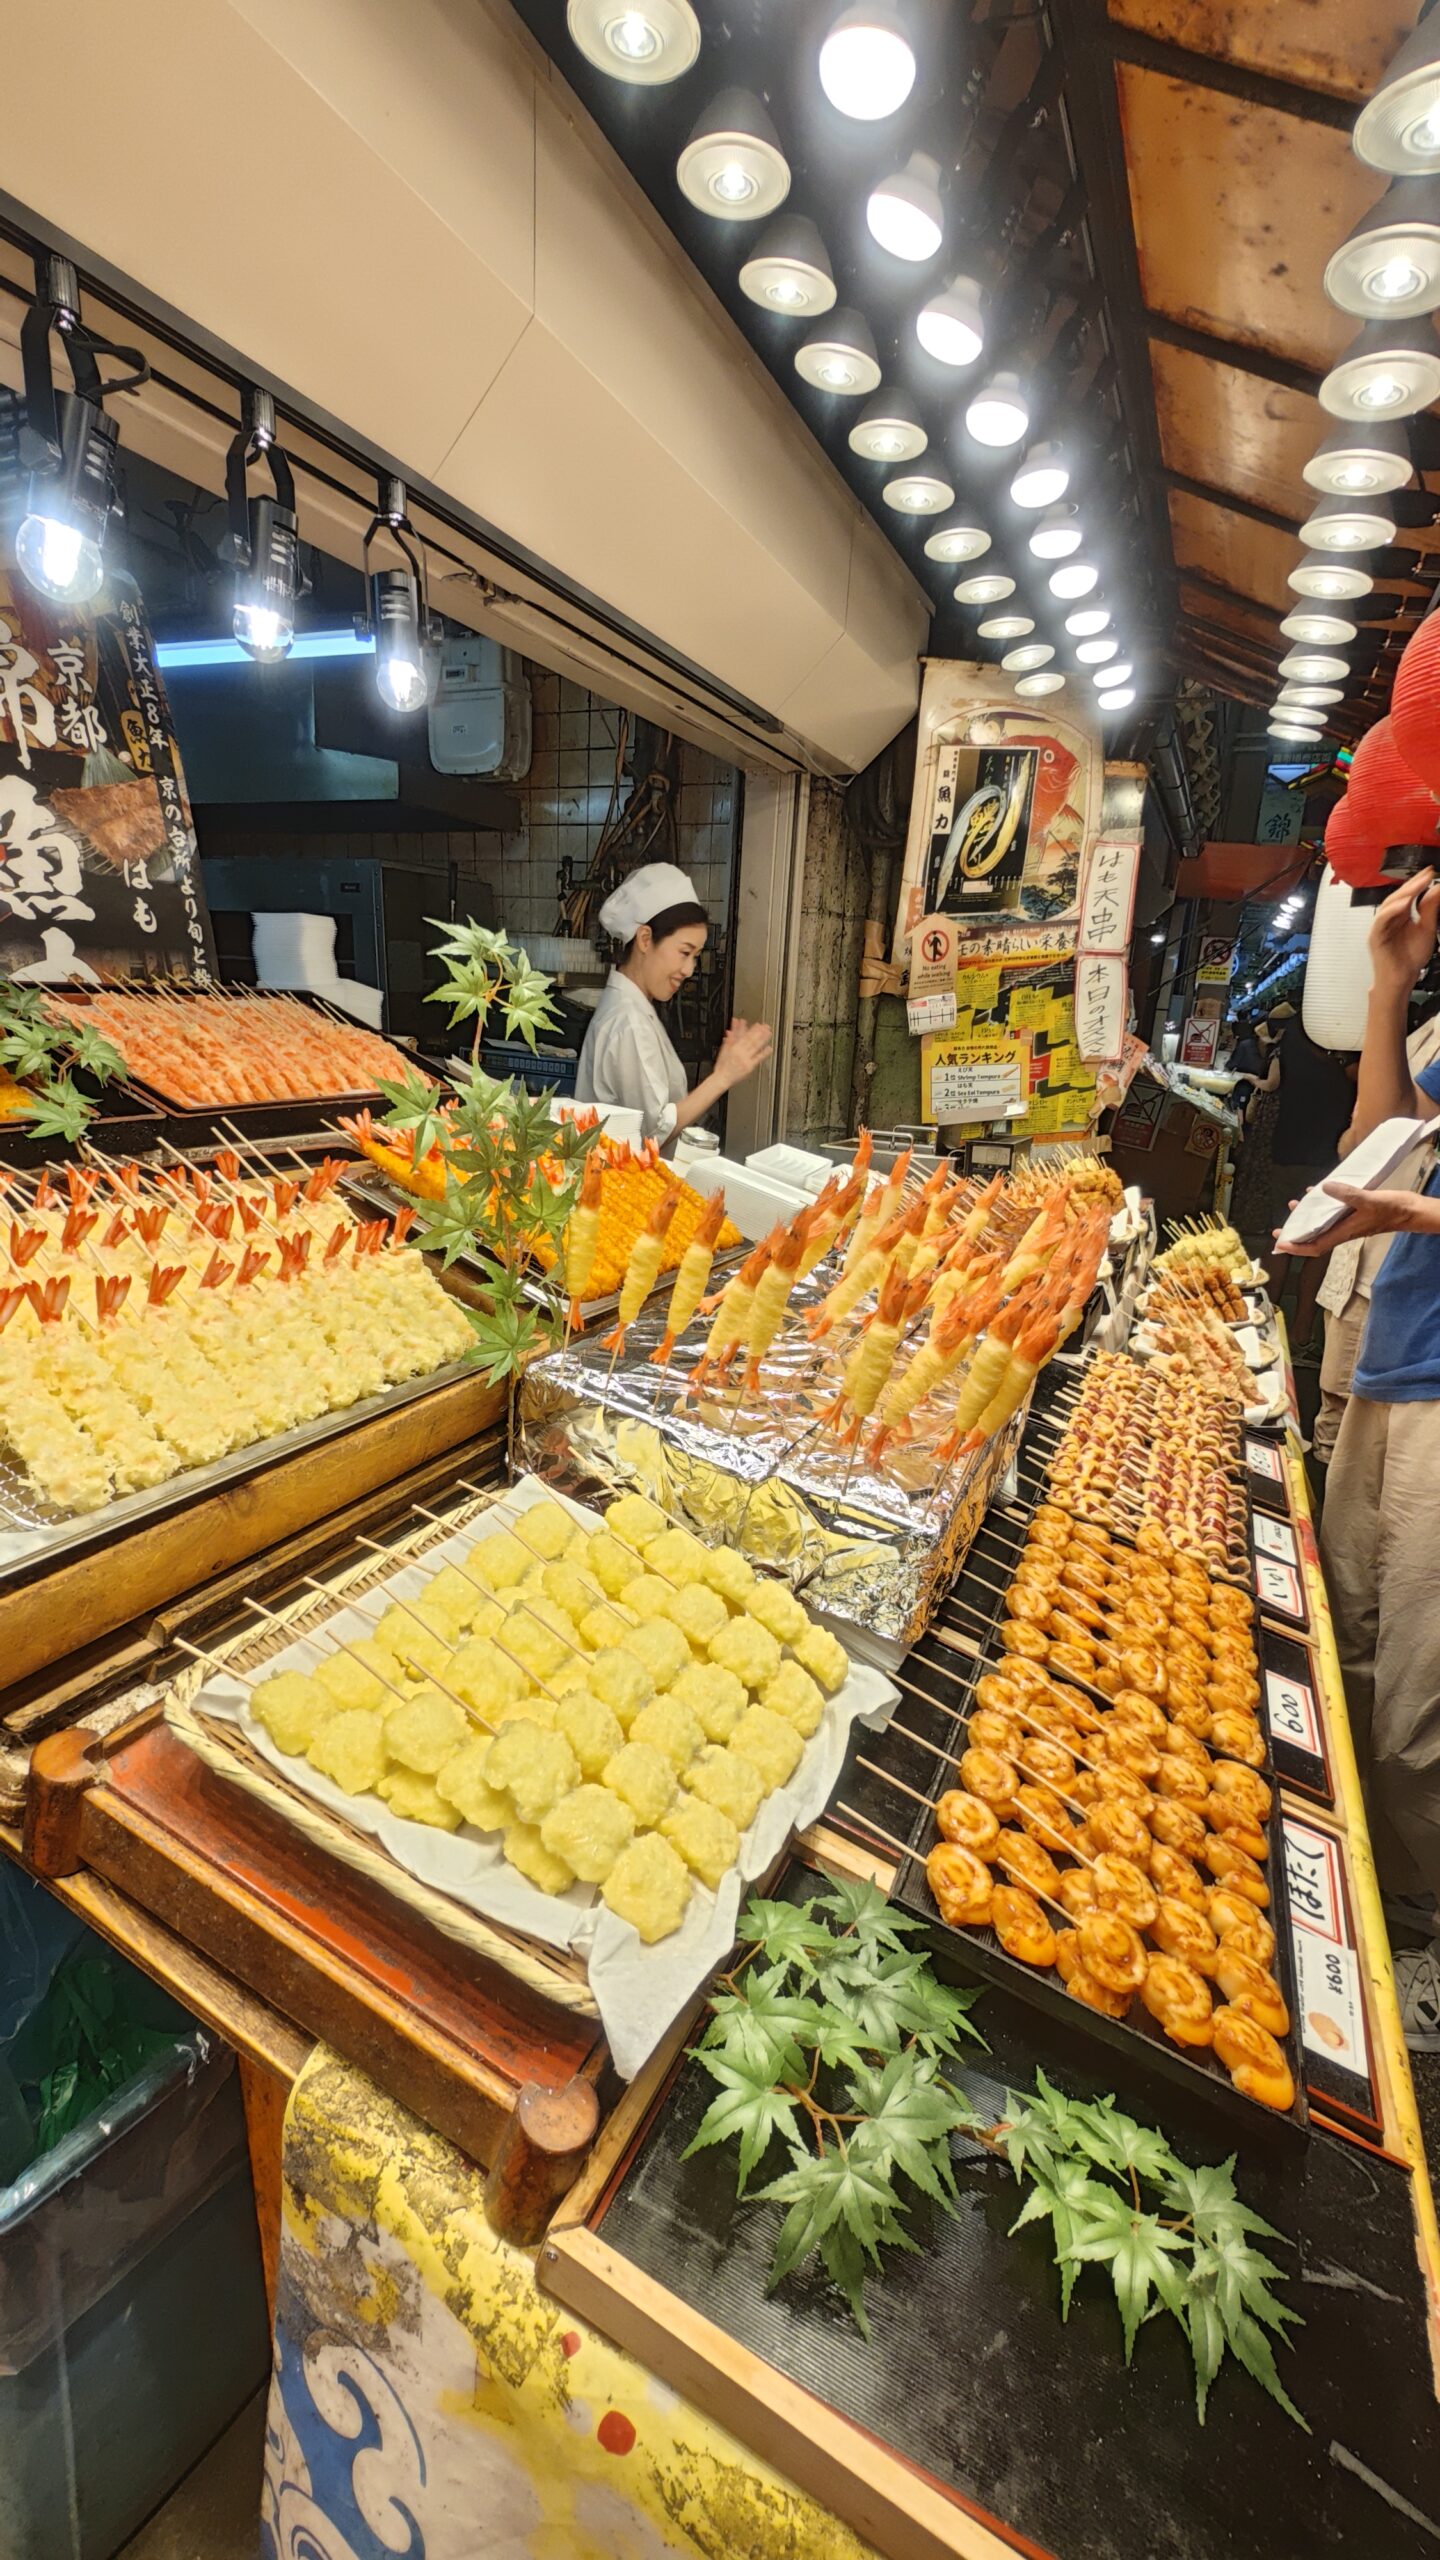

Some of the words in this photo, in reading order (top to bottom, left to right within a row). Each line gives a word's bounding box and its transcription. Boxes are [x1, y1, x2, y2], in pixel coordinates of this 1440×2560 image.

[47, 639, 107, 754] 京都
[119, 600, 169, 749] 創業大正8年
[123, 858, 157, 933] はも
[935, 1050, 1016, 1067] 人気ランキング
[1273, 1693, 1304, 1734] 600
[1283, 1834, 1325, 1921] ほたて
[1325, 1953, 1344, 1996] ¥600
